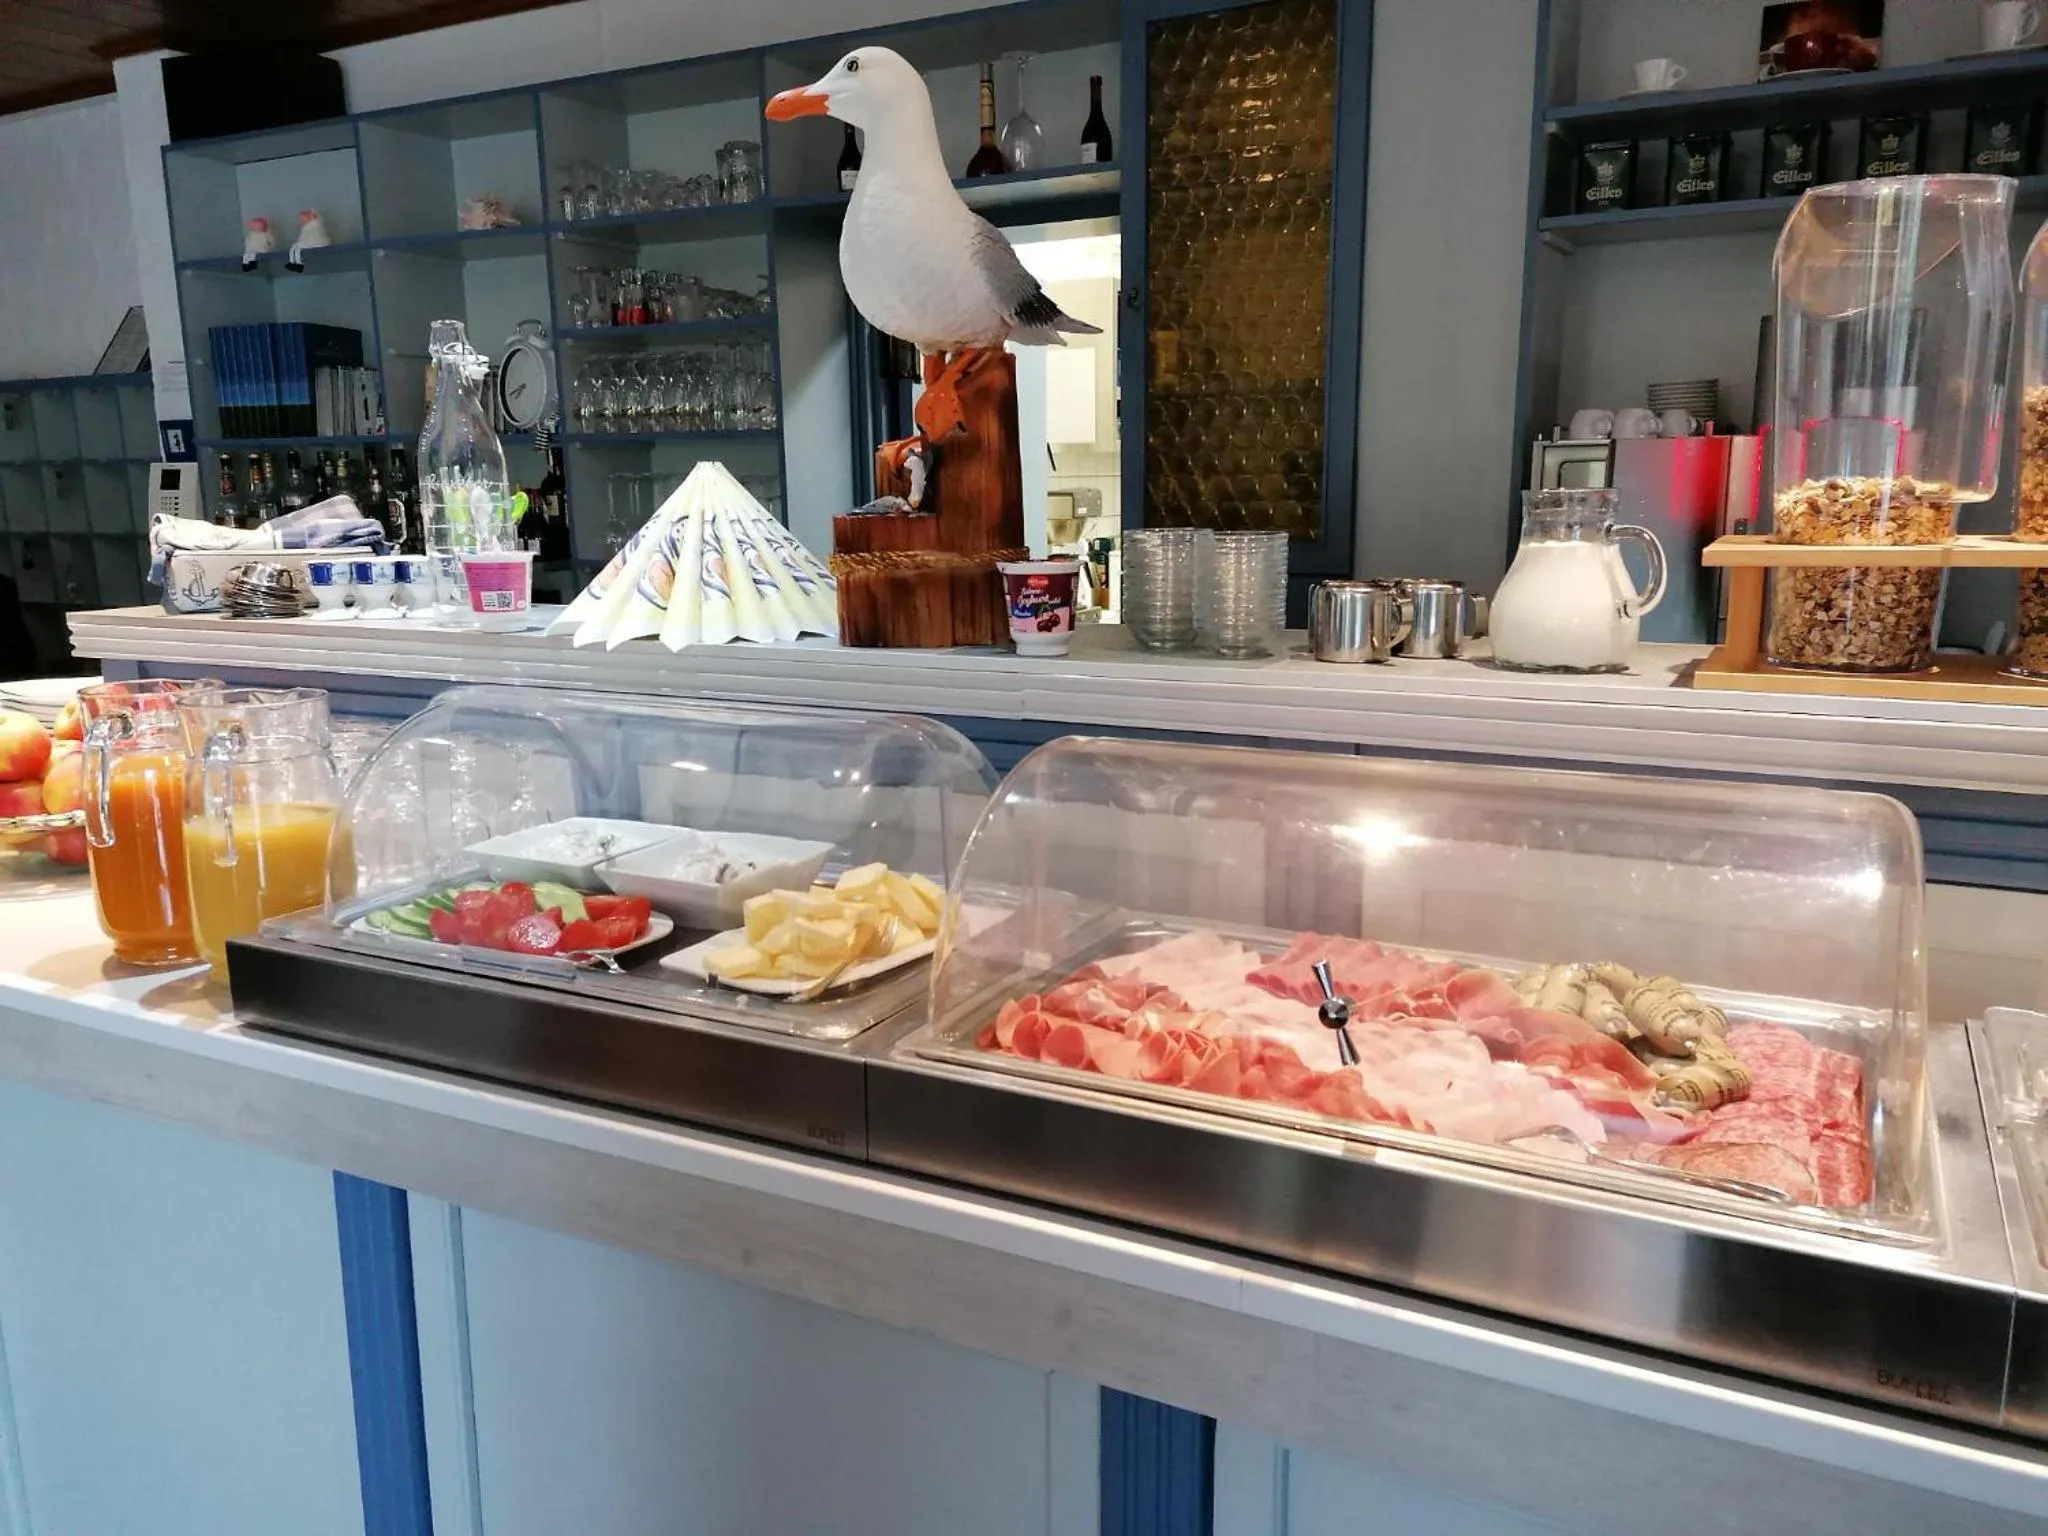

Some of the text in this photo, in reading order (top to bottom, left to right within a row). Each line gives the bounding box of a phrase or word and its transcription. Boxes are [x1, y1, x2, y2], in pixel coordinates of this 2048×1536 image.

[1866, 159, 1911, 176] Eilles
[1772, 169, 1813, 184] Eilles
[1676, 178, 1716, 193] Eilles
[1585, 187, 1623, 201] Eilles
